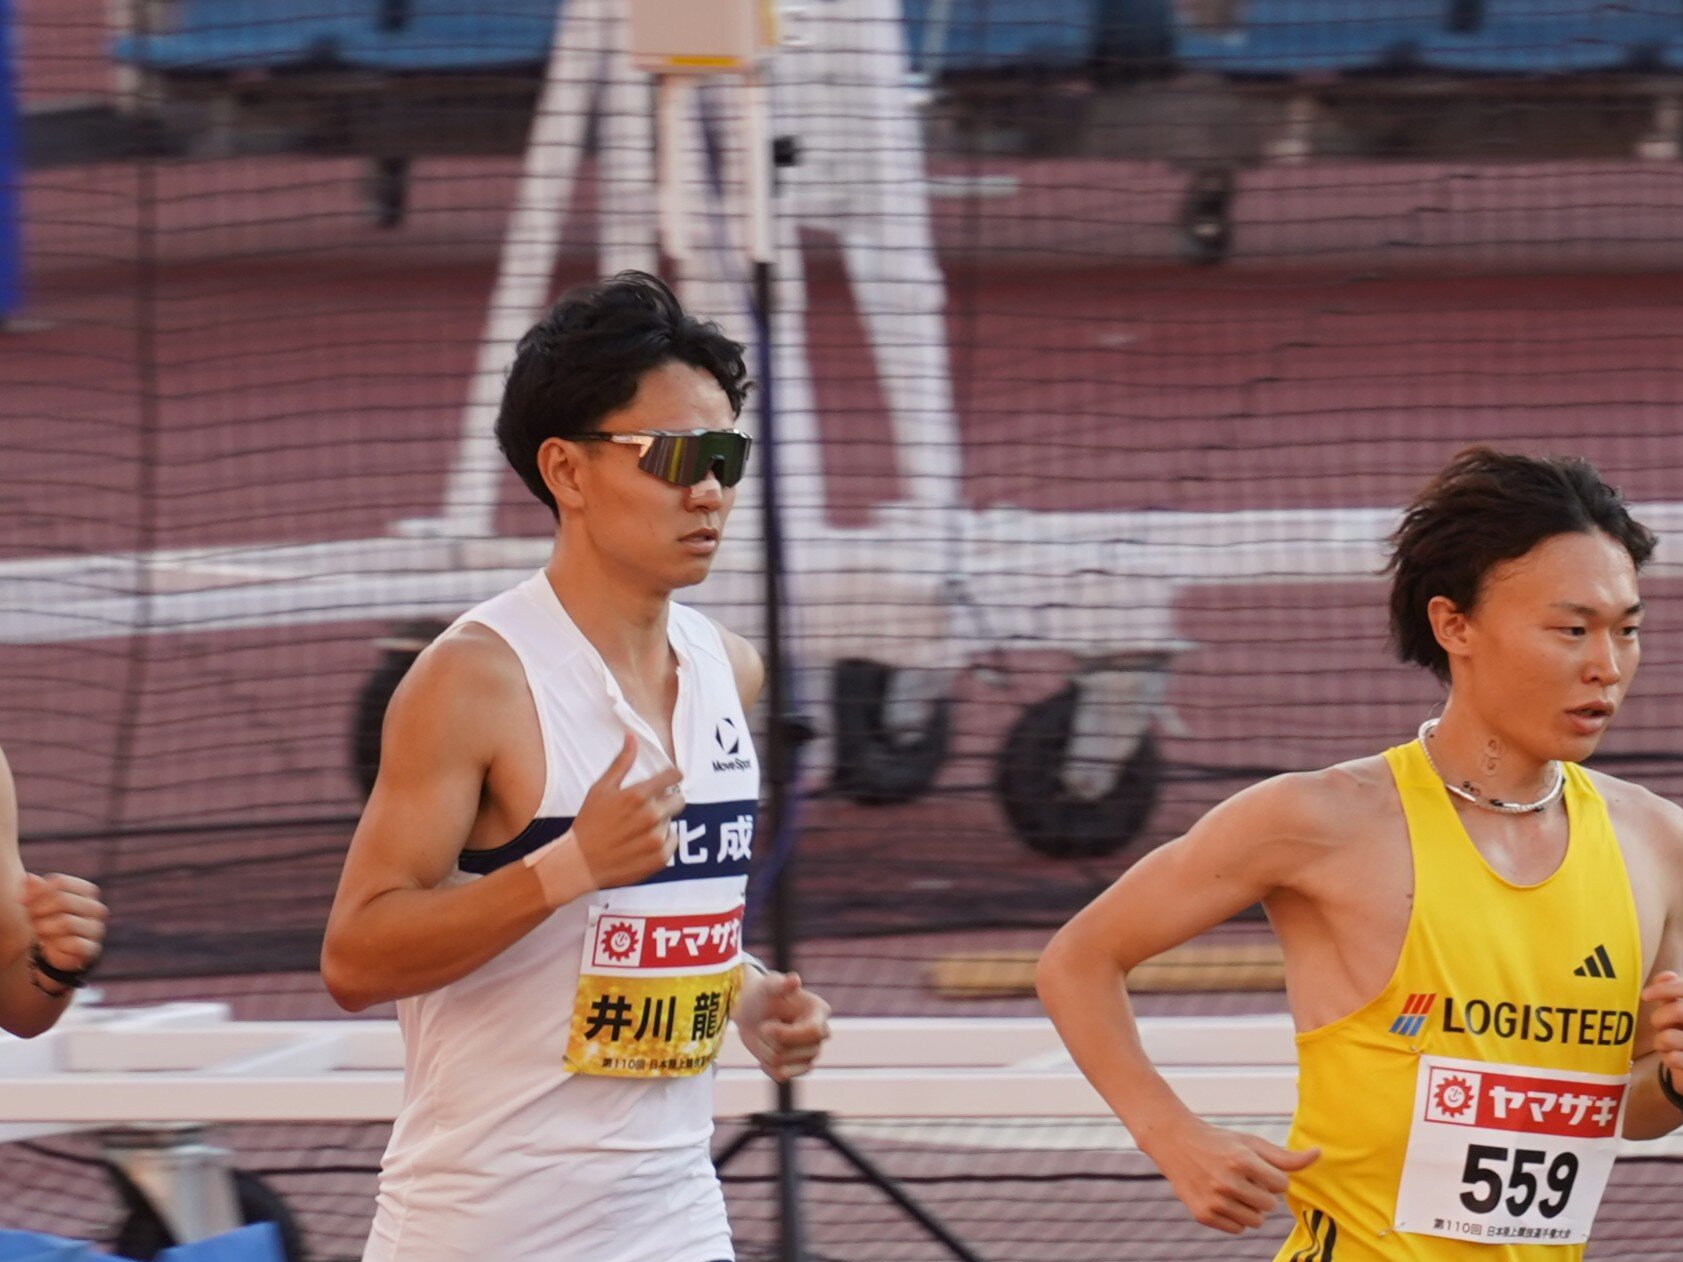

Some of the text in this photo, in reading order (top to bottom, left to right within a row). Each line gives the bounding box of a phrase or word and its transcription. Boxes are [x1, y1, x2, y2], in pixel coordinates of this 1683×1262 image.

[584, 994, 677, 1042] 井川
[1443, 997, 1635, 1046] LOGISTEED
[1488, 1085, 1618, 1128] ヤマザキ
[1459, 1143, 1579, 1219] 559
[1433, 1218, 1483, 1236] 第110回
